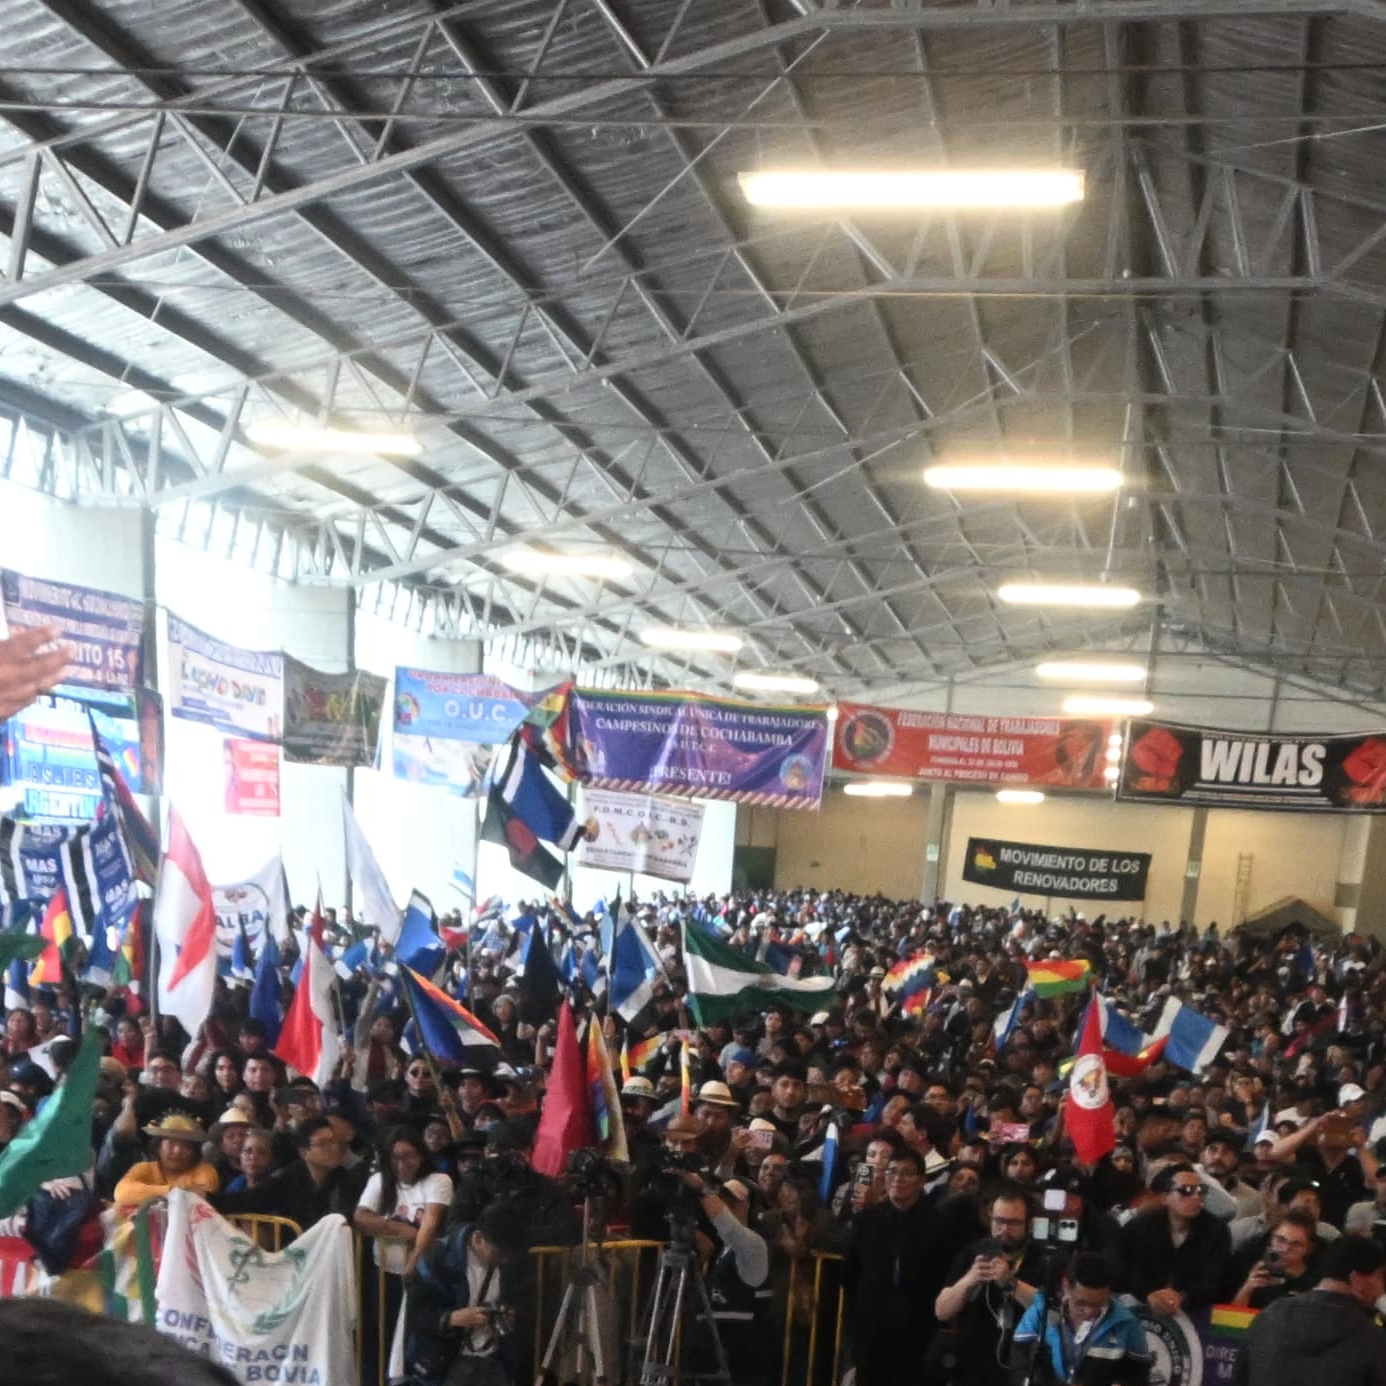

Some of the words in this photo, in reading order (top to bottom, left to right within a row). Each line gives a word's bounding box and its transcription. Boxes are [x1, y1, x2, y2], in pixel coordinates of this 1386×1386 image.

[106, 647, 125, 669] 15
[700, 725, 793, 747] COCHABAMBA
[1200, 738, 1327, 787] WILAS
[1000, 847, 1086, 872] MOVIMIENTO
[1088, 857, 1110, 873] DE
[1112, 857, 1141, 874] LOS
[1013, 869, 1119, 893] RENOVADORES
